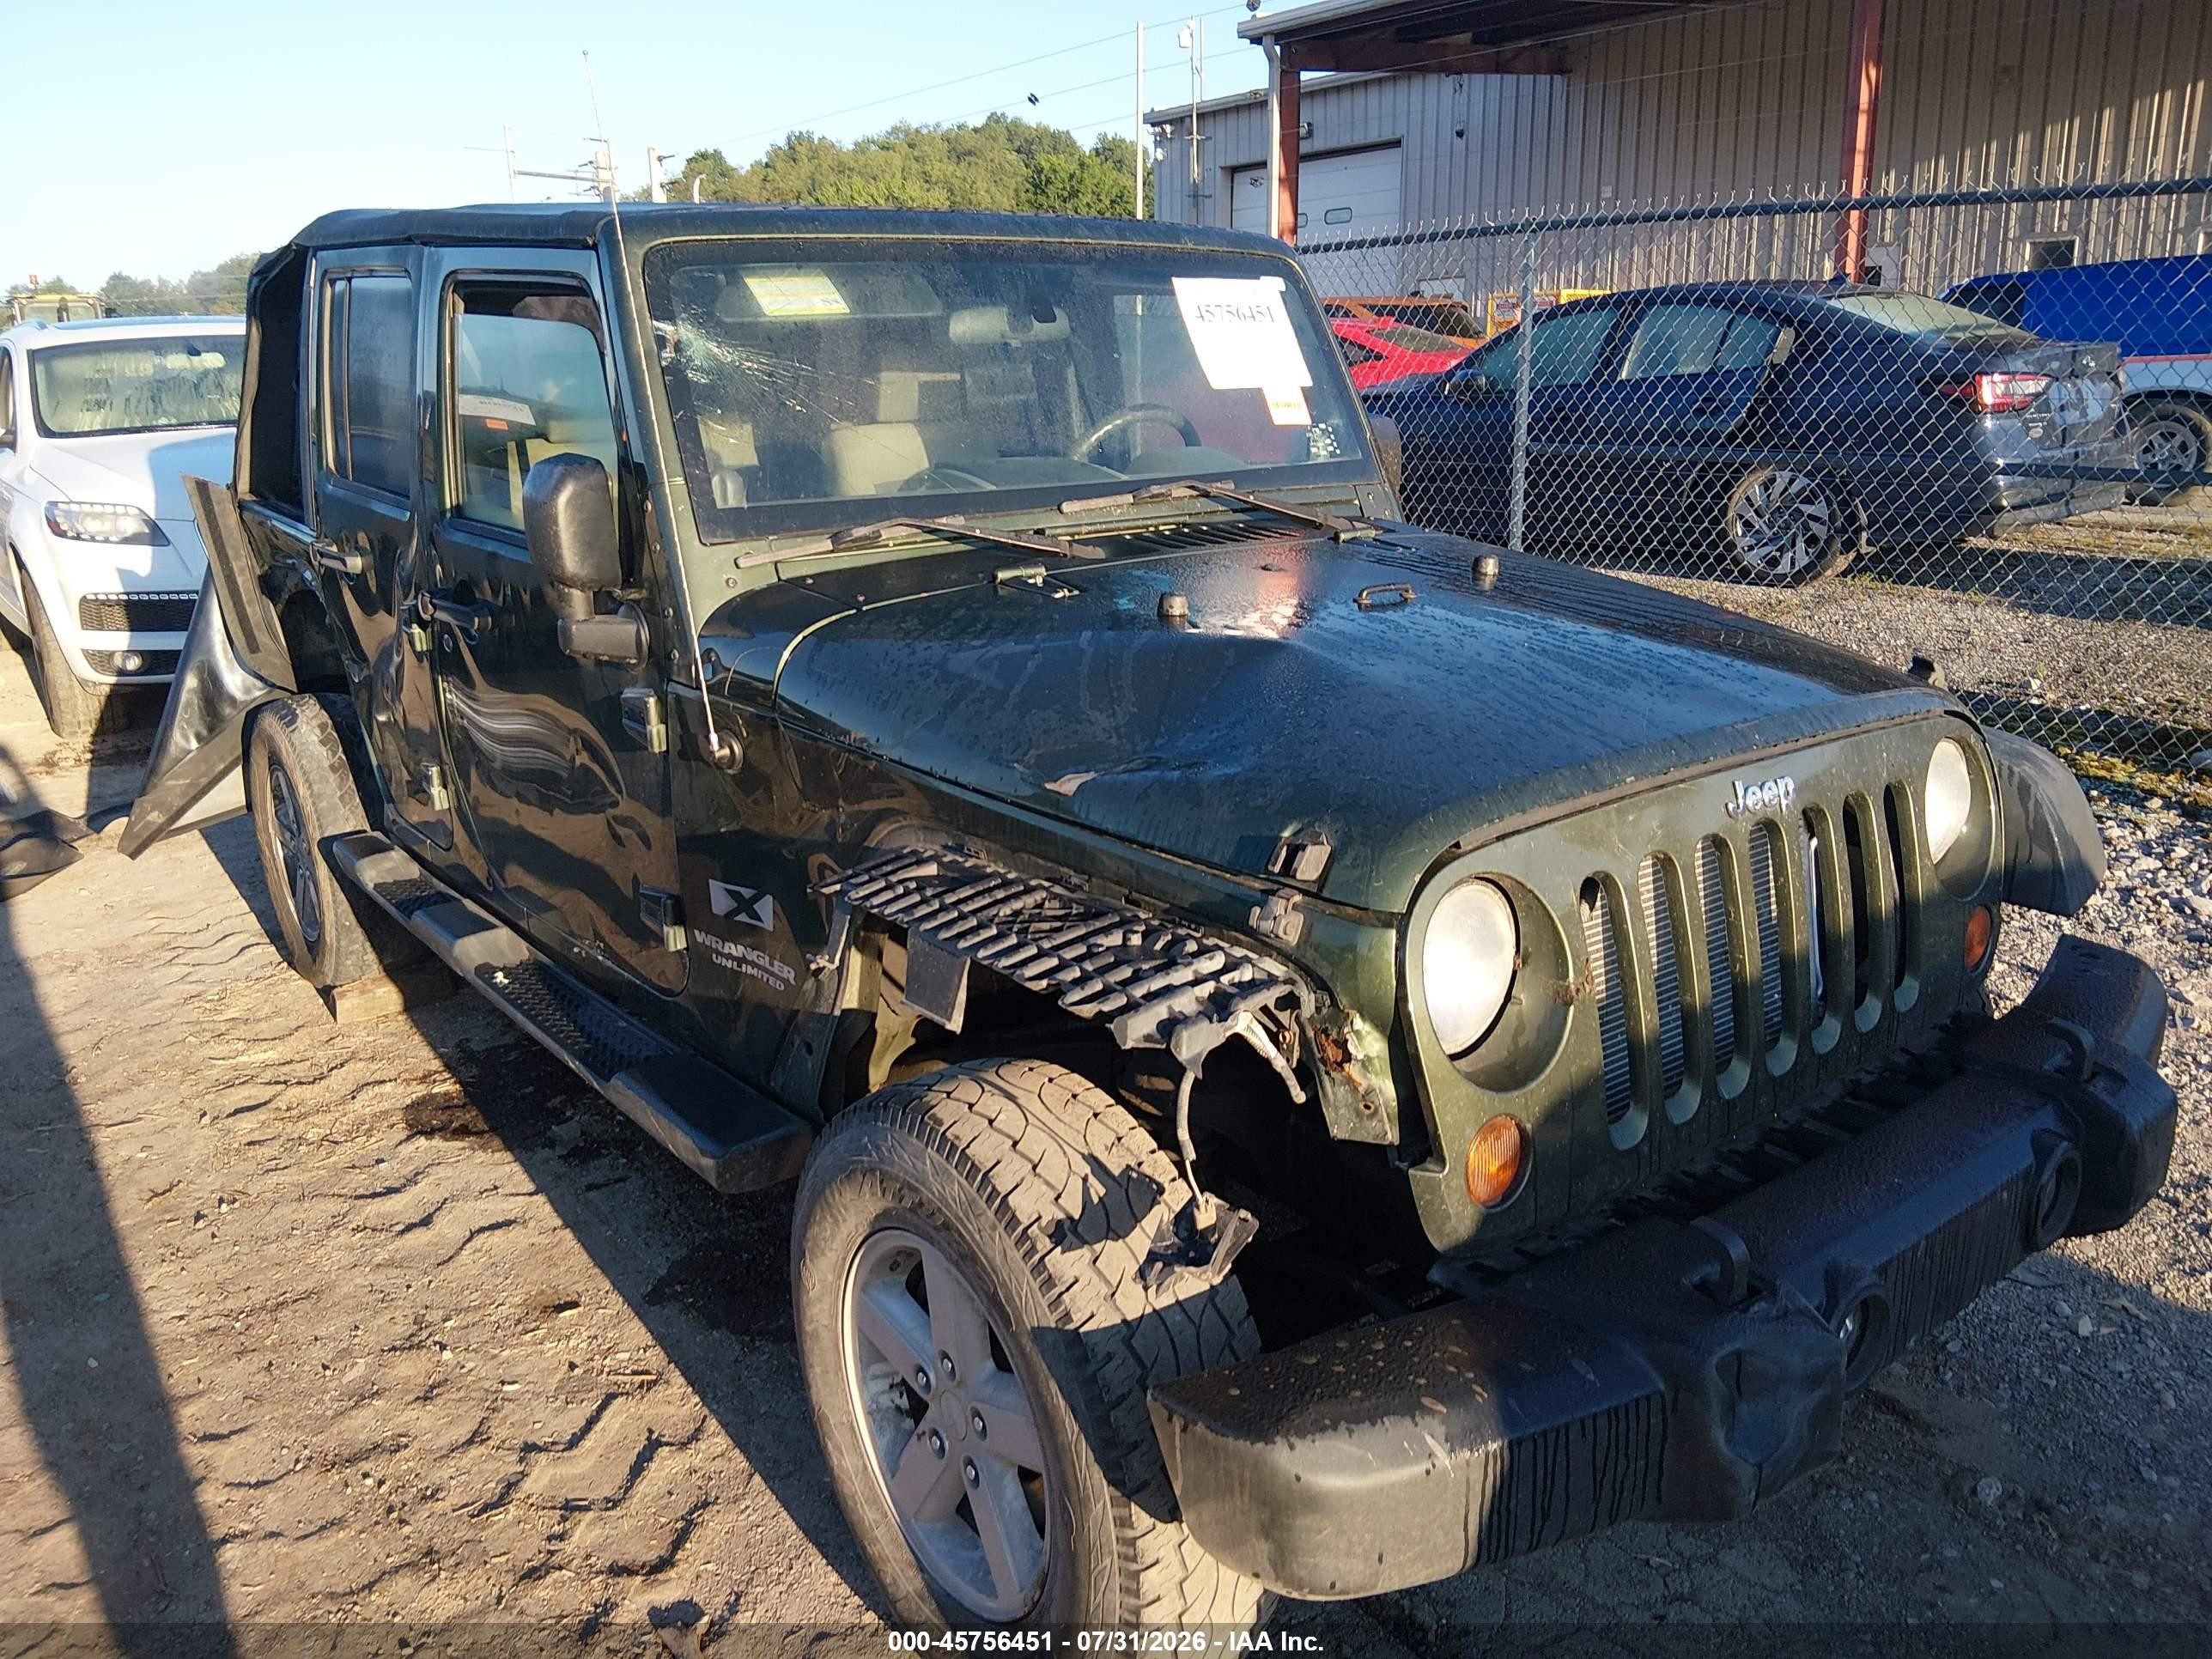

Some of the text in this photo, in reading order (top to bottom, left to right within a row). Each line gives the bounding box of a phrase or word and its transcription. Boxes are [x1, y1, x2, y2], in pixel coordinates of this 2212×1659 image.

[1194, 303, 1275, 323] 45756451
[1724, 776, 1796, 818] Jeep
[693, 928, 797, 986] WRANGLER
[712, 952, 785, 991] UNLIMITED
